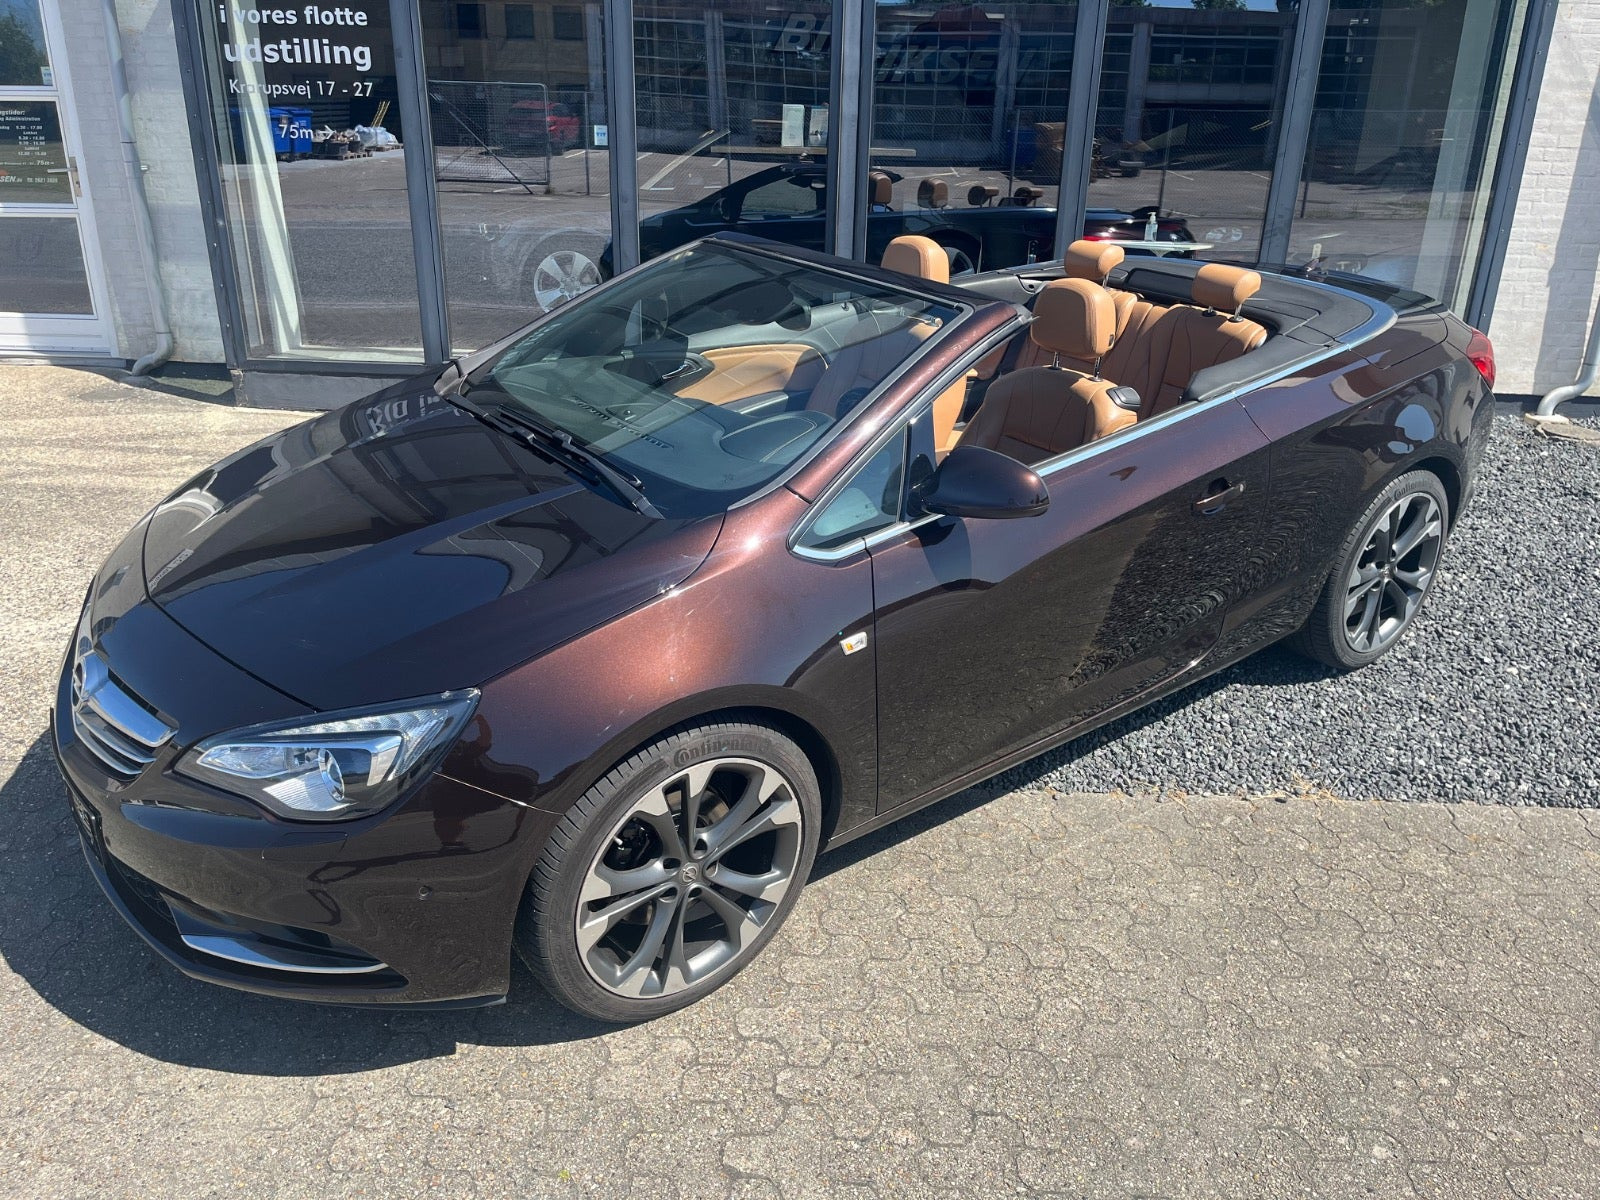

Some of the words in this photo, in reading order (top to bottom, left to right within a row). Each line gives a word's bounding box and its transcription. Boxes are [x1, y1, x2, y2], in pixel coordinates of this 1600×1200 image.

[219, 5, 226, 23] i
[233, 8, 298, 25] vores
[304, 6, 368, 26] flotte
[224, 37, 372, 71] udstilling
[229, 79, 311, 99] Krarupsvej
[317, 81, 335, 96] 17
[353, 82, 373, 97] 27
[279, 124, 314, 139] 75m
